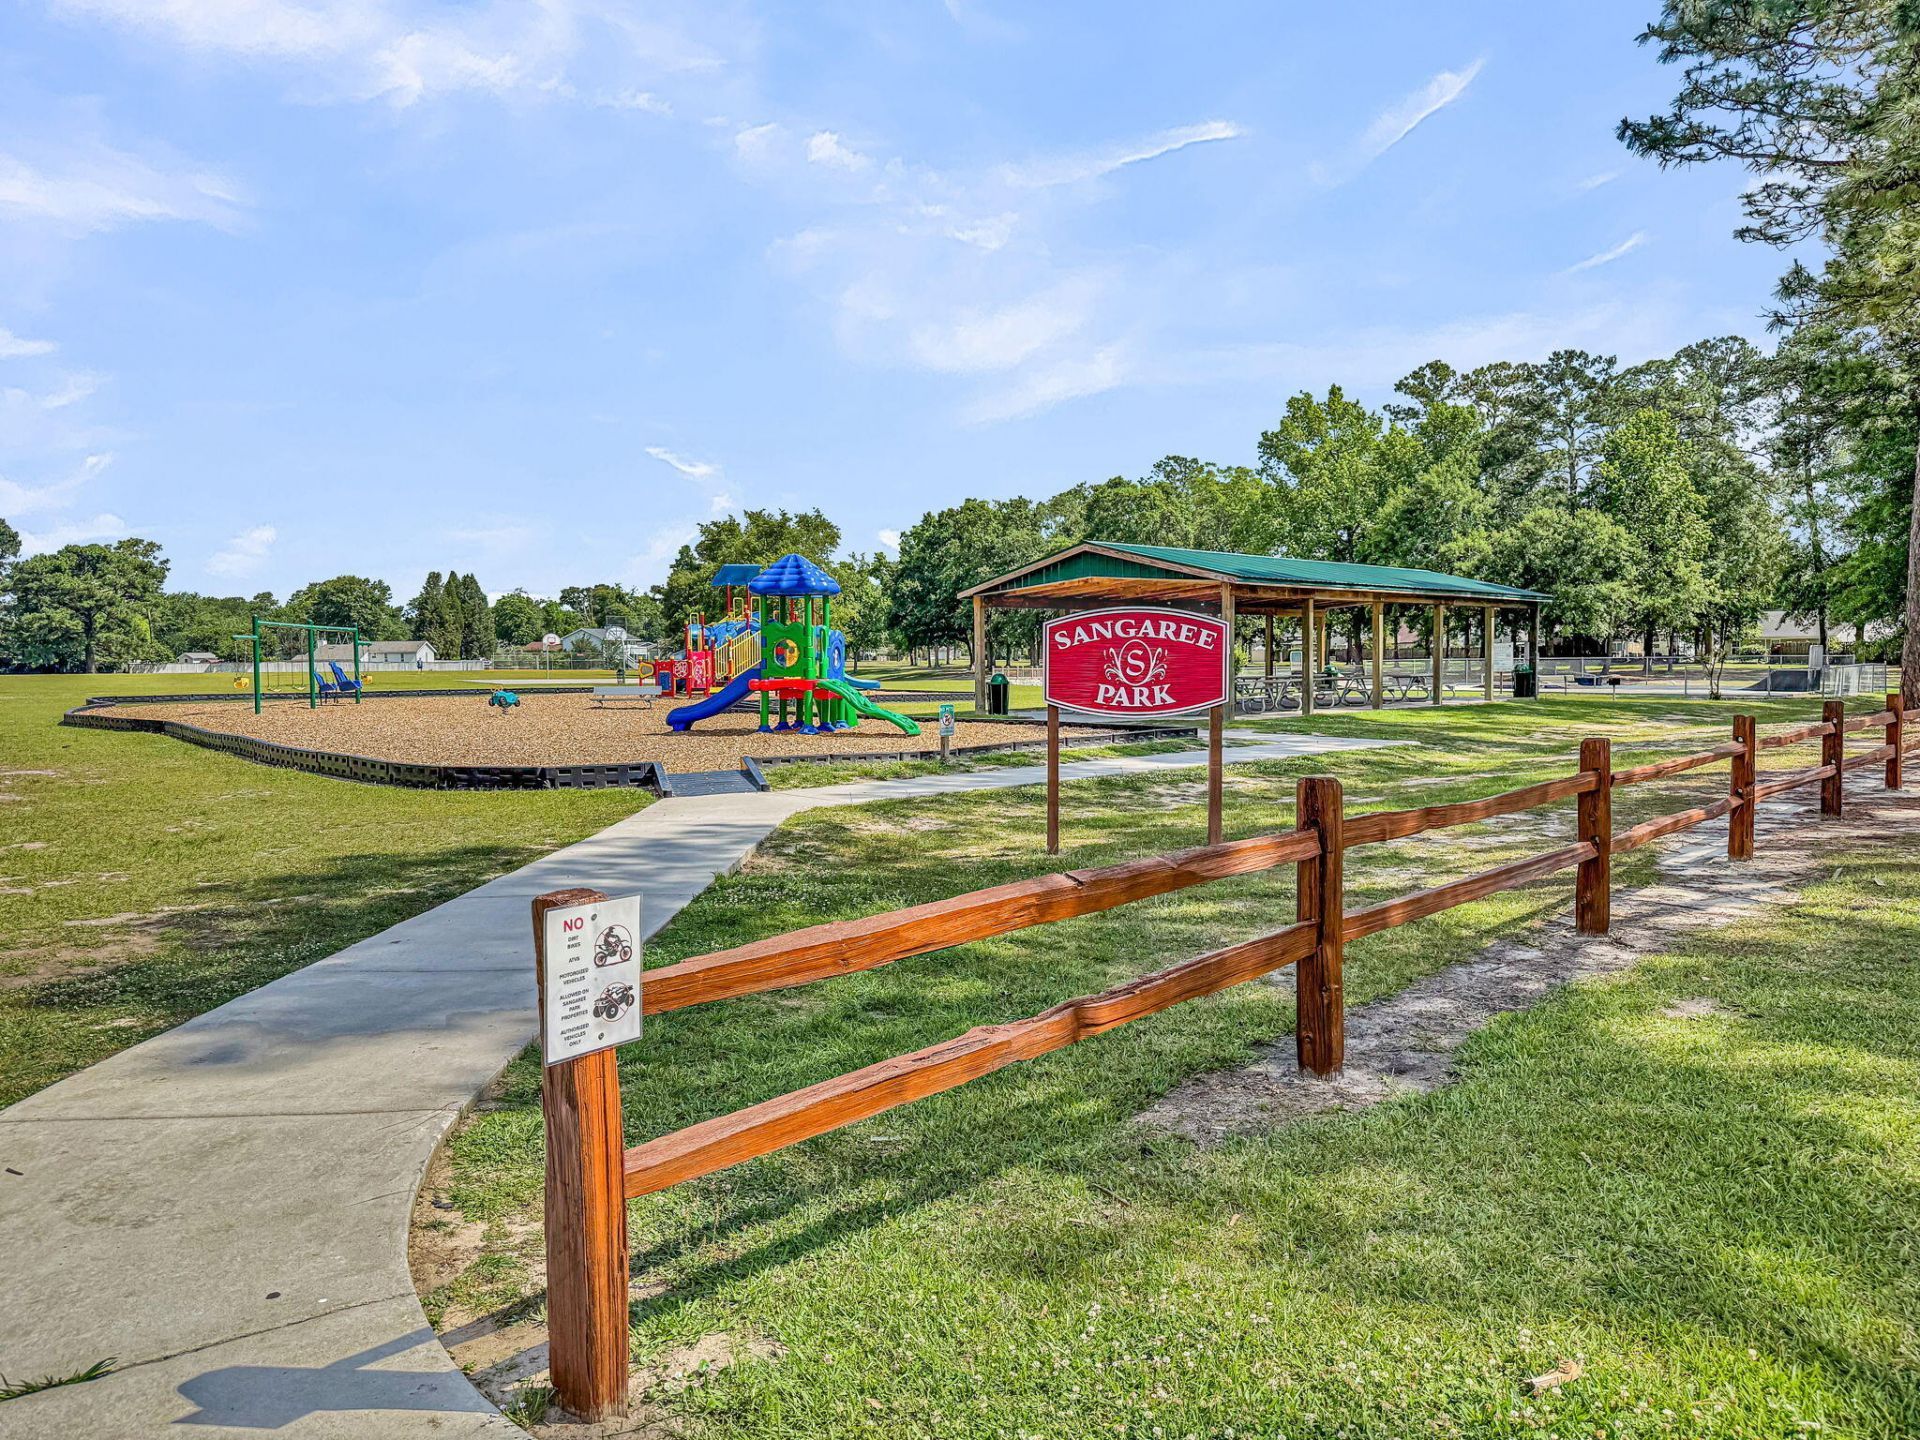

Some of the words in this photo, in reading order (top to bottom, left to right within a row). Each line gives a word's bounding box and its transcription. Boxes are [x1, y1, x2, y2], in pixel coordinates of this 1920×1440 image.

[1054, 619, 1218, 650] SANGAREE
[1126, 649, 1146, 676] S
[1094, 683, 1177, 707] PARK
[563, 917, 584, 932] NO
[559, 967, 589, 979] MOTORIZED
[563, 975, 586, 985] VEHICLES
[559, 990, 582, 1000] ALLOWED
[562, 996, 587, 1006] SANGAREE
[568, 1004, 581, 1012] PARK
[561, 1009, 588, 1021] PROPERTIES
[560, 1023, 590, 1035] AUTHORIZED
[563, 1031, 586, 1041] VEHICLES
[568, 1039, 582, 1047] ONLY
